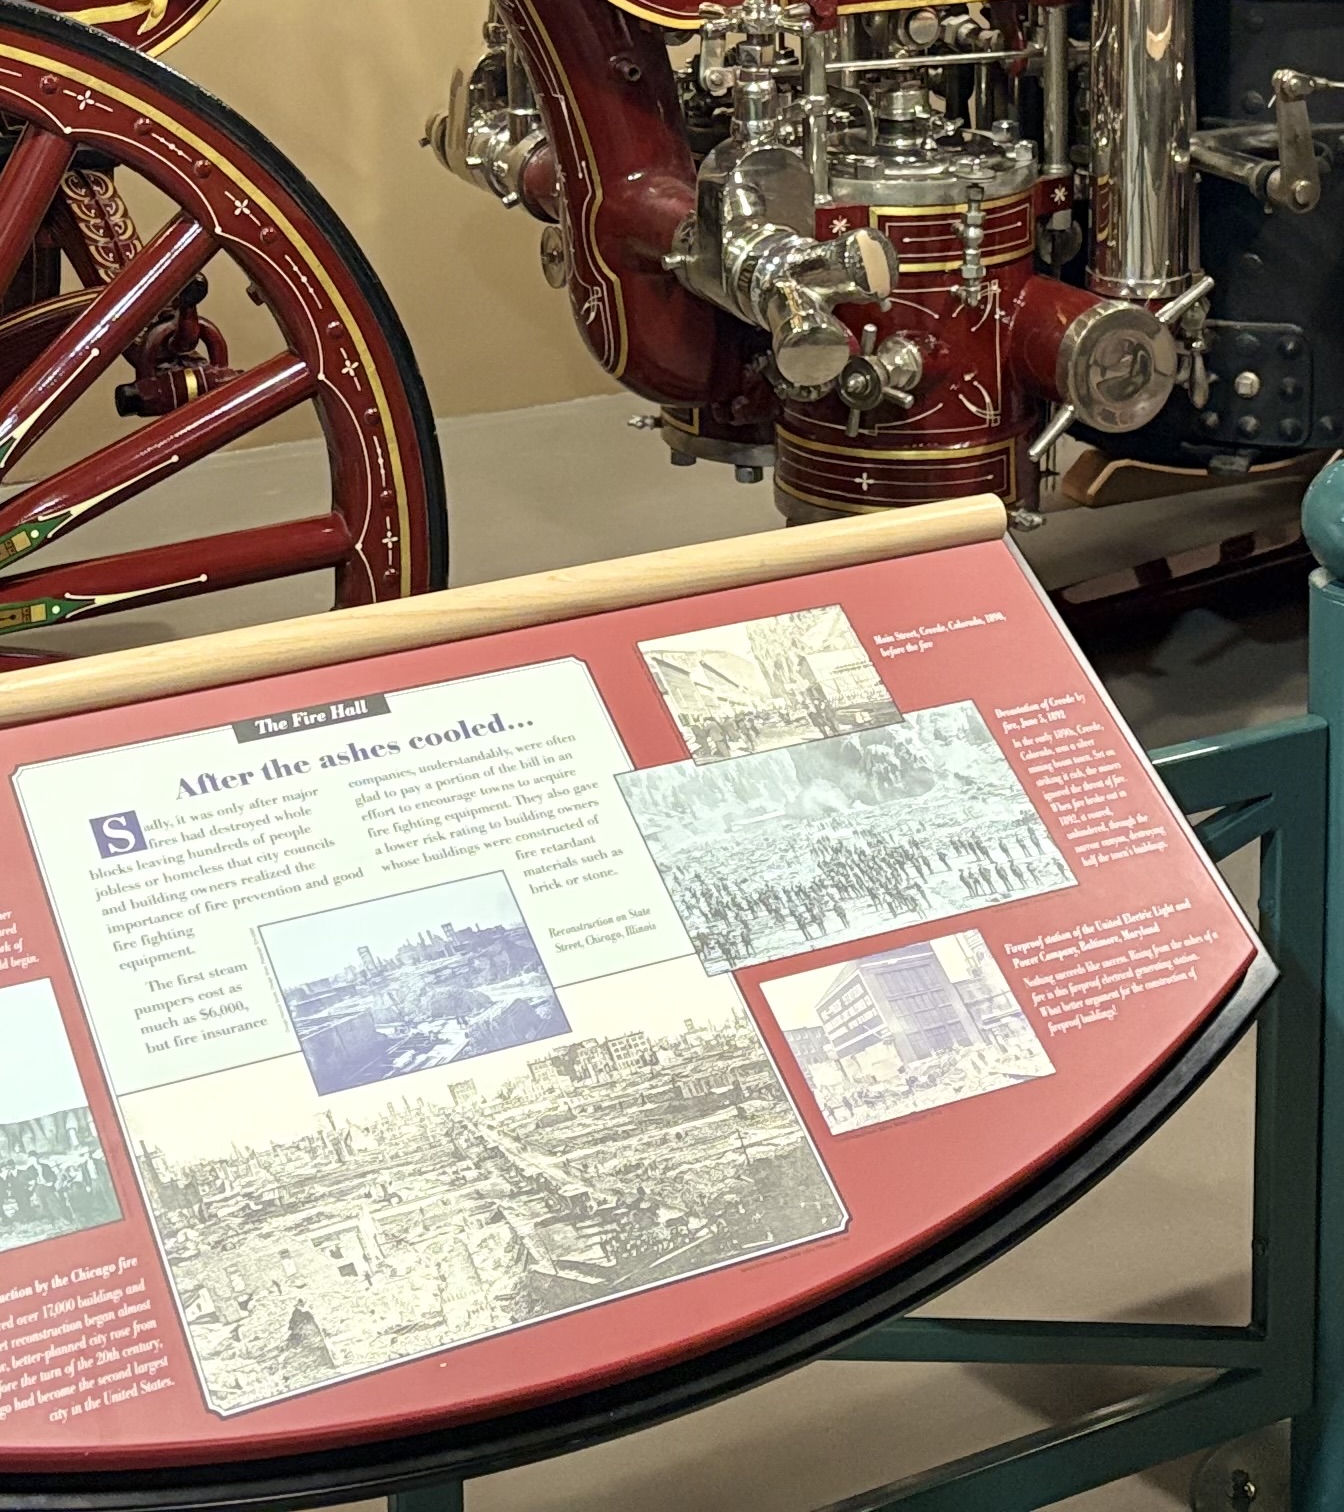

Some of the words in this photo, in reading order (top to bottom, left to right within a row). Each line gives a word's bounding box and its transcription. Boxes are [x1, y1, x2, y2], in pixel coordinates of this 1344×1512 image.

[255, 719, 287, 734] The
[292, 712, 326, 727] Fire
[330, 700, 368, 719] Hall
[178, 771, 254, 799] After
[261, 758, 309, 780] the
[319, 741, 400, 768] ashes
[409, 712, 533, 749] cooled...
[515, 741, 542, 752] were
[546, 734, 576, 746] often
[355, 790, 381, 809] glad
[384, 790, 396, 798] to
[400, 785, 420, 799] pay
[436, 772, 480, 792] portion
[483, 765, 495, 776] of
[498, 762, 516, 773] the
[519, 755, 540, 769] bill
[543, 755, 555, 764] in
[559, 752, 573, 761] an
[362, 807, 396, 821] effort
[399, 804, 412, 813] to
[415, 790, 476, 810] encourage
[480, 783, 515, 795] towns
[517, 779, 530, 787] to
[534, 769, 576, 785] acquire
[176, 815, 186, 824] it
[190, 812, 213, 821] was
[217, 802, 243, 816] only
[250, 797, 277, 809] after
[282, 788, 318, 803] major
[368, 827, 389, 838] fire
[393, 815, 442, 834] fighting
[445, 799, 511, 823] equipment.
[513, 794, 542, 806] They
[547, 787, 570, 798] also
[573, 781, 598, 797] gave
[149, 837, 178, 849] fires
[181, 827, 205, 842] had
[210, 813, 270, 837] destroyed
[275, 805, 311, 821] whole
[375, 847, 382, 855] a
[384, 839, 418, 852] lower
[423, 830, 446, 844] risk
[450, 824, 487, 839] rating
[489, 821, 501, 829] to
[503, 809, 556, 827] building
[557, 800, 599, 814] owners
[381, 857, 419, 871] whose
[422, 844, 480, 863] buildings
[483, 837, 511, 848] were
[516, 816, 584, 841] constructed
[587, 813, 599, 825] of
[89, 863, 133, 880] blocks
[136, 853, 185, 871] leaving
[187, 837, 249, 859] hundreds
[253, 832, 265, 844] of
[269, 824, 311, 846] people
[515, 849, 536, 860] fire
[540, 835, 596, 854] retardant
[523, 856, 578, 877] materials
[581, 849, 608, 863] such
[611, 848, 623, 856] as
[96, 882, 141, 903] jobless
[145, 877, 159, 887] or
[162, 864, 224, 883] homeless
[227, 856, 253, 869] that
[257, 852, 278, 864] city
[284, 837, 335, 856] councils
[102, 900, 126, 915] and
[130, 890, 188, 910] building
[190, 880, 237, 895] owners
[241, 863, 291, 885] realized
[295, 861, 315, 872] the
[529, 878, 563, 894] brick
[566, 876, 579, 885] or
[108, 911, 183, 934] importance
[188, 902, 201, 915] of
[205, 900, 228, 912] fire
[232, 884, 301, 910] prevention
[306, 874, 329, 889] and
[333, 866, 364, 887] good
[113, 940, 136, 952] fire
[141, 927, 195, 948] fighting
[548, 916, 614, 938] Reconstruction
[616, 914, 627, 922] on
[628, 907, 650, 918] State
[625, 921, 656, 936] Illinois
[119, 946, 195, 972] equipment.
[145, 979, 172, 992] The
[177, 971, 205, 985] first
[209, 963, 248, 978] steam
[134, 995, 194, 1020] pumpers
[198, 986, 224, 1000] cost
[229, 983, 242, 993] as
[141, 1016, 179, 1034] much
[183, 1015, 196, 1024] as
[145, 1040, 170, 1053] but
[174, 1035, 197, 1047] fire
[202, 1018, 267, 1040] insurance
[35, 1281, 48, 1296] by
[51, 1276, 68, 1288] the
[71, 1264, 116, 1282] Chicago
[118, 1257, 137, 1274] fire
